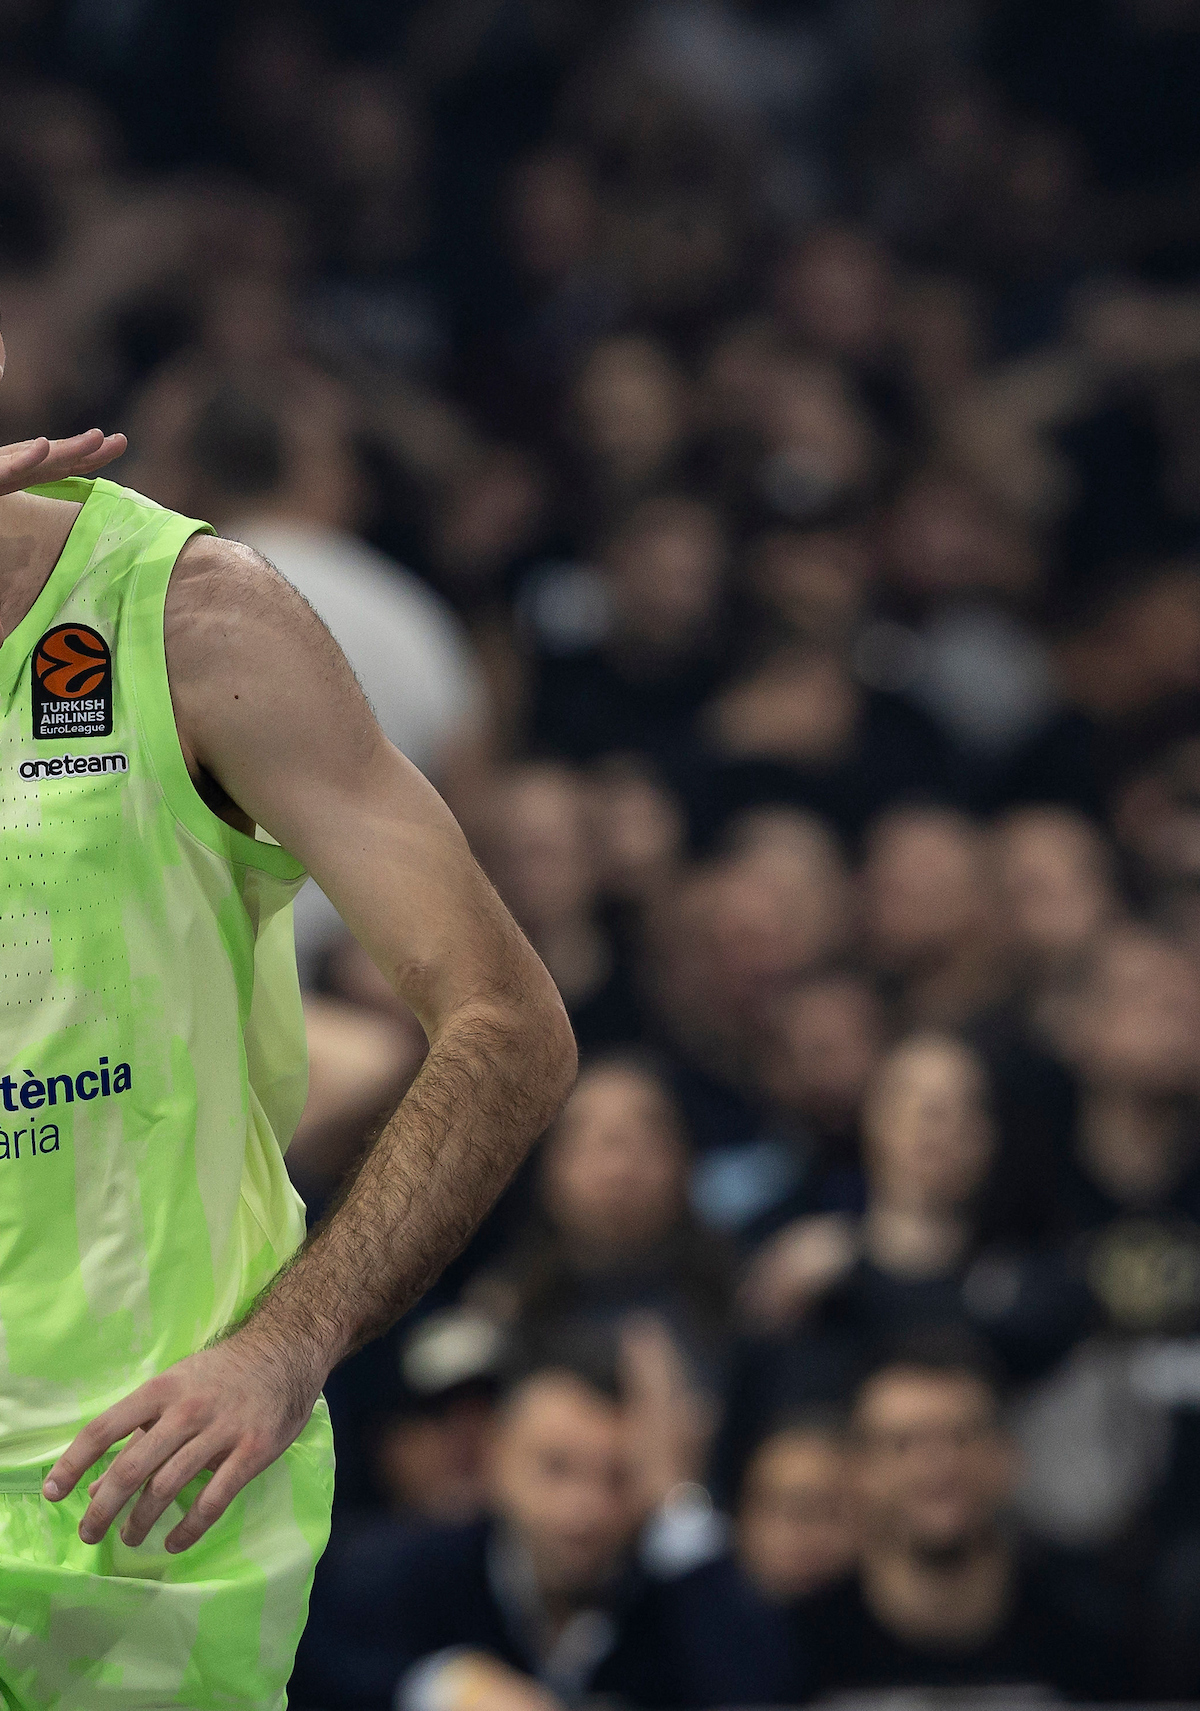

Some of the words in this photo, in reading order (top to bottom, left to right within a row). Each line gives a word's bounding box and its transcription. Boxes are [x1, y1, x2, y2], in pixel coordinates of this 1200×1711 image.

[40, 698, 105, 713] TURKISH
[40, 711, 105, 725] AIRLINES
[39, 723, 105, 735] EuroLeague
[19, 754, 127, 779] oneteam
